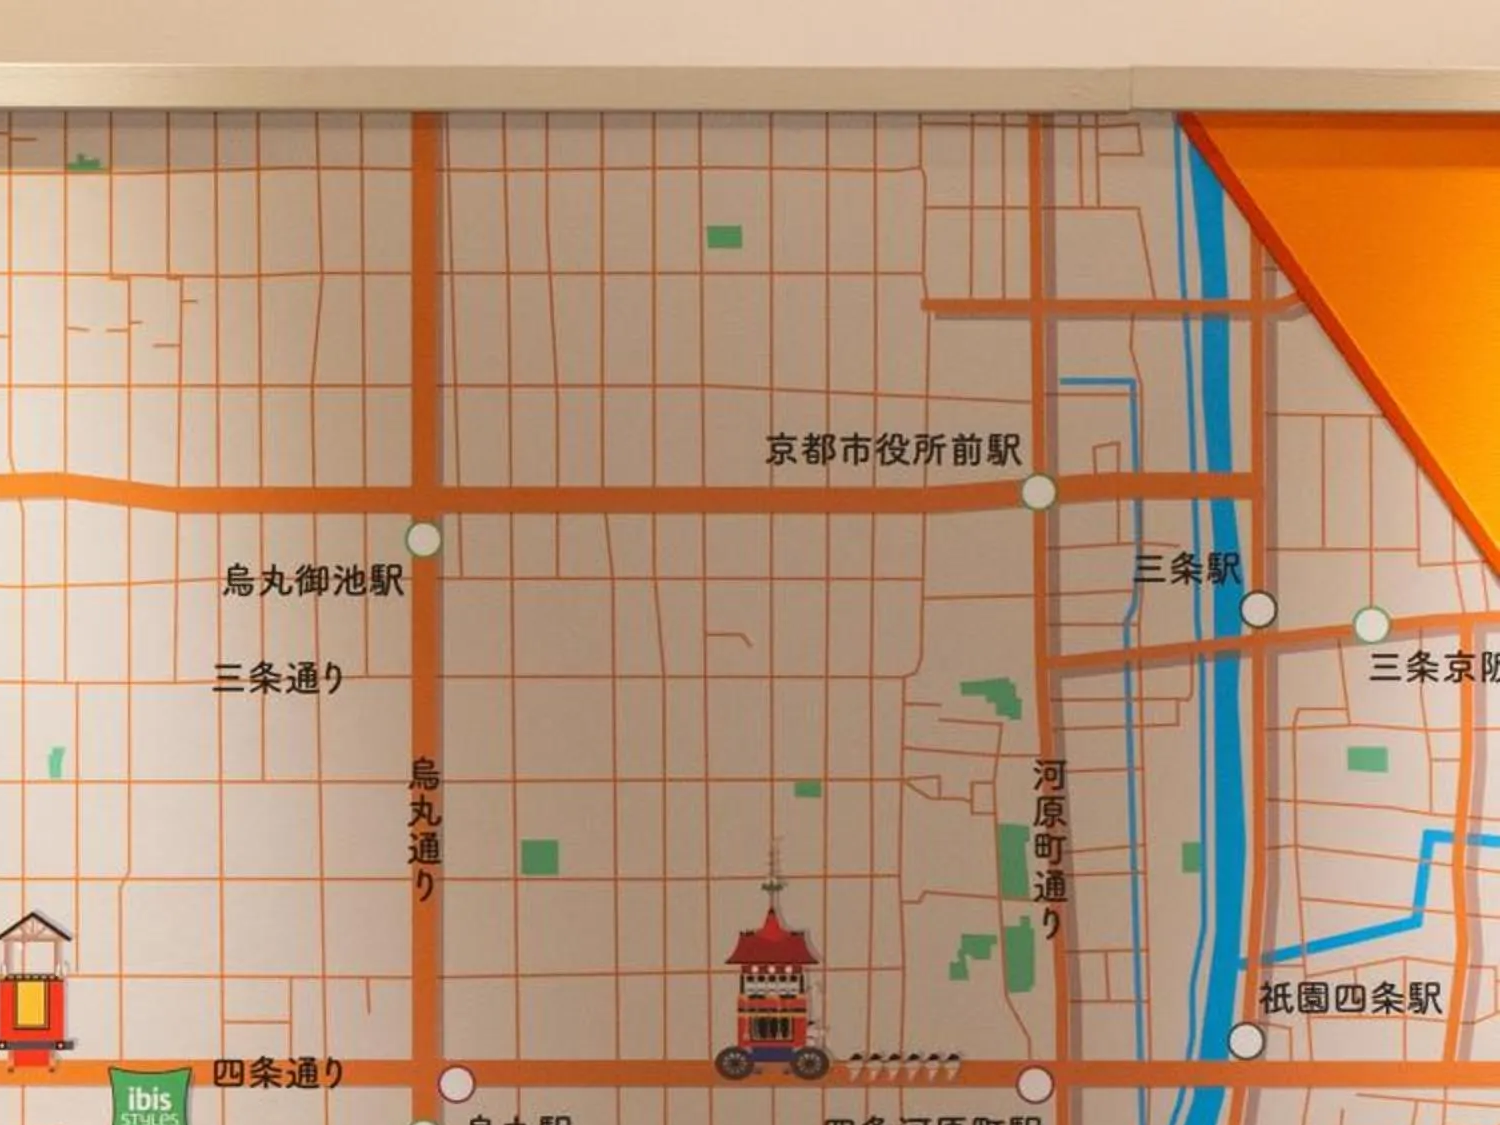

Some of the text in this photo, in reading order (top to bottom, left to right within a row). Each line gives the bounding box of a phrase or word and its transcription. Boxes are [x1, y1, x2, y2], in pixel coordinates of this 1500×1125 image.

[765, 432, 1021, 467] 京都市役所前駅
[1134, 551, 1241, 585] 三条駅
[212, 661, 343, 694] 三条通り
[1033, 759, 1068, 940] 河原町通り
[213, 1056, 344, 1089] 四条通り
[128, 1086, 172, 1111] ibis
